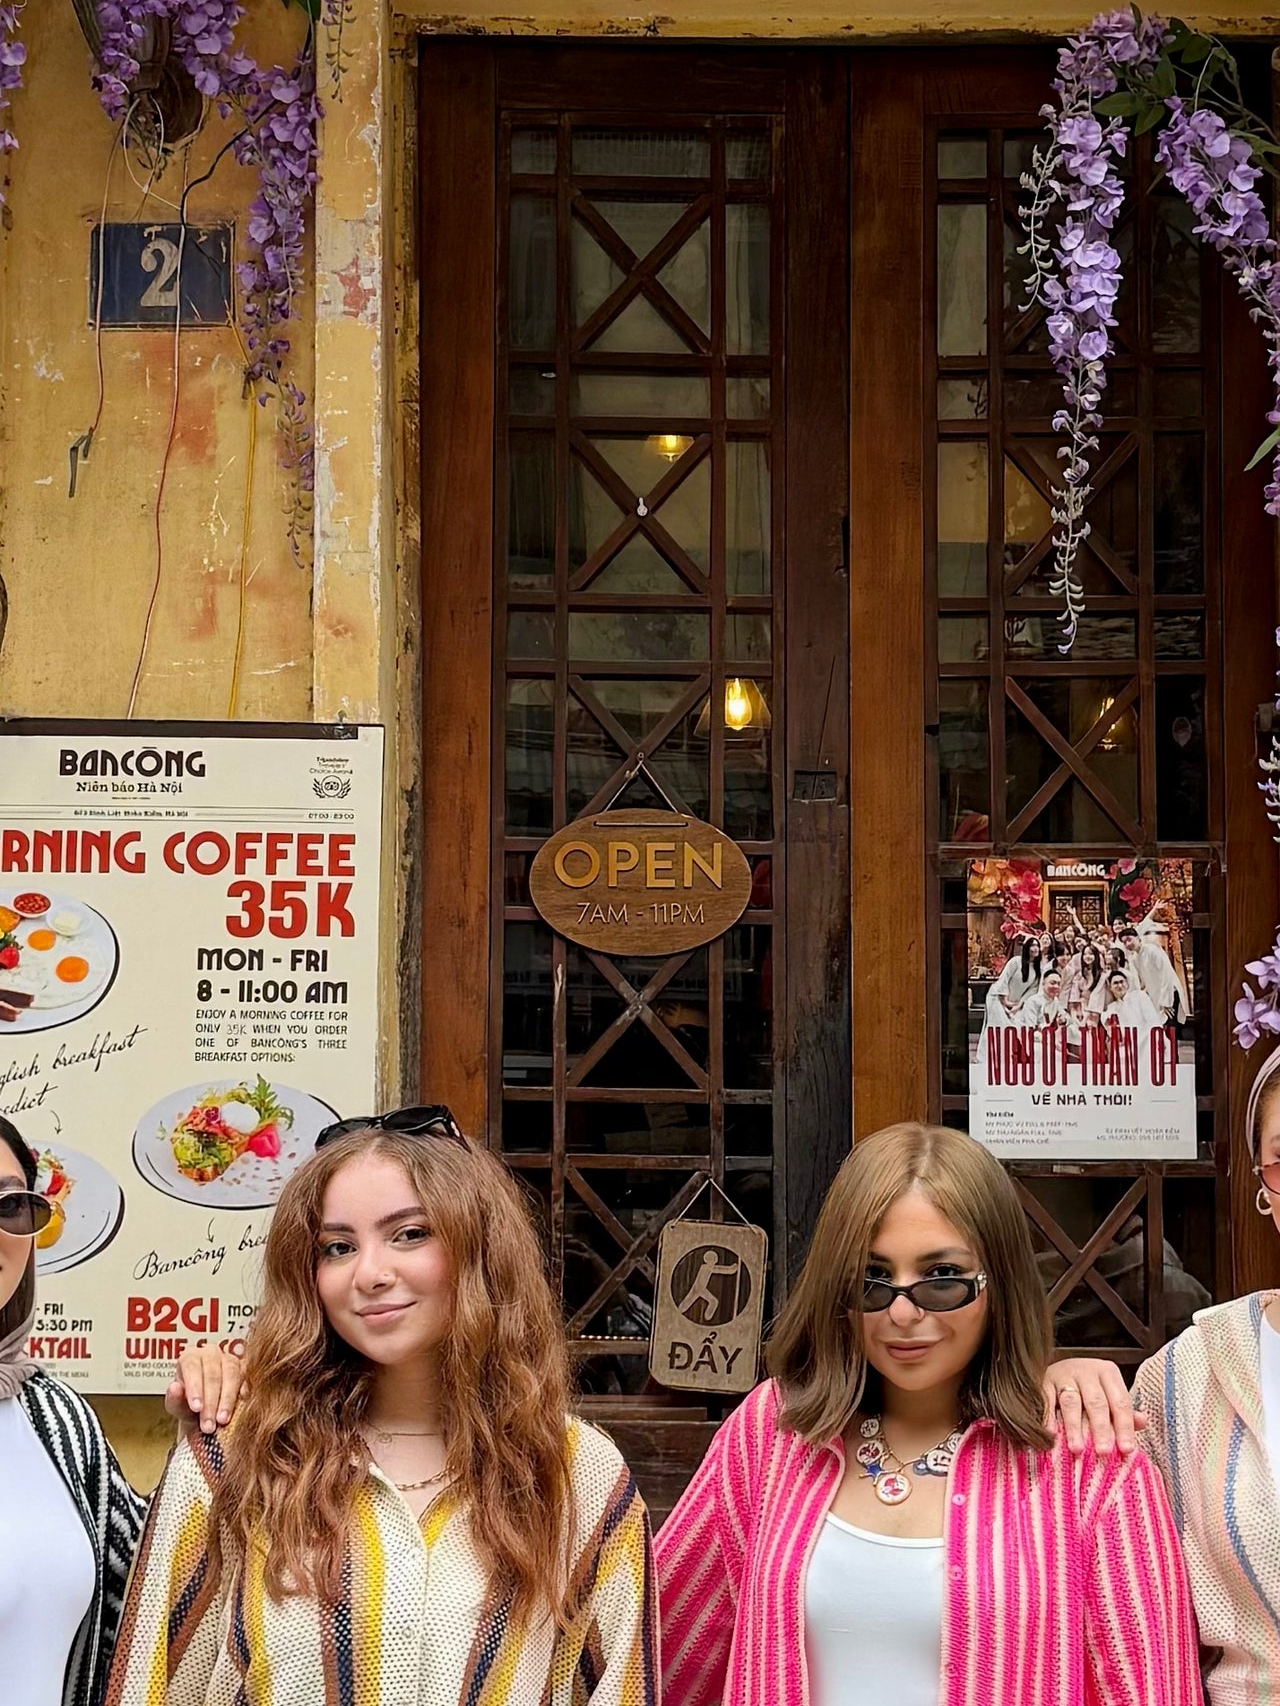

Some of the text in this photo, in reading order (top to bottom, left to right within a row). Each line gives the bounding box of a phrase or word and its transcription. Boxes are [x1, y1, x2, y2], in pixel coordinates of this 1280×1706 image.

[140, 238, 179, 307] 2
[59, 746, 206, 778] BANCÔNG
[76, 781, 183, 795] Niên báo Hà Nội
[163, 831, 356, 876] COFFEE
[554, 841, 723, 890] OPEN
[226, 880, 355, 938] 35K
[576, 902, 629, 925] 7AM
[652, 902, 705, 925] 11PM
[197, 948, 264, 971] MON
[290, 949, 328, 972] FRI
[197, 979, 212, 1002] 8
[238, 980, 298, 1003] 11:00
[305, 981, 348, 1004] AM
[195, 1009, 348, 1021] ENJOY A MORNING COFFEE FOR
[195, 1024, 221, 1033] ONLY
[252, 1024, 281, 1034] WHEN
[287, 1025, 308, 1034] YOU
[315, 1025, 348, 1035] ORDER
[52, 1024, 149, 1072] breakfast
[195, 1037, 215, 1047] ONE
[226, 1038, 240, 1047] OF
[318, 1039, 348, 1049] THREE
[194, 1052, 296, 1062] BREAKFAST OPTIONS:
[1, 1082, 59, 1115] edict
[132, 1245, 227, 1281] Bancông
[44, 1303, 64, 1315] FRI
[36, 1319, 93, 1332] 5:30 PM
[30, 1337, 92, 1358] KTAIL
[668, 1331, 743, 1375] ĐẨY
